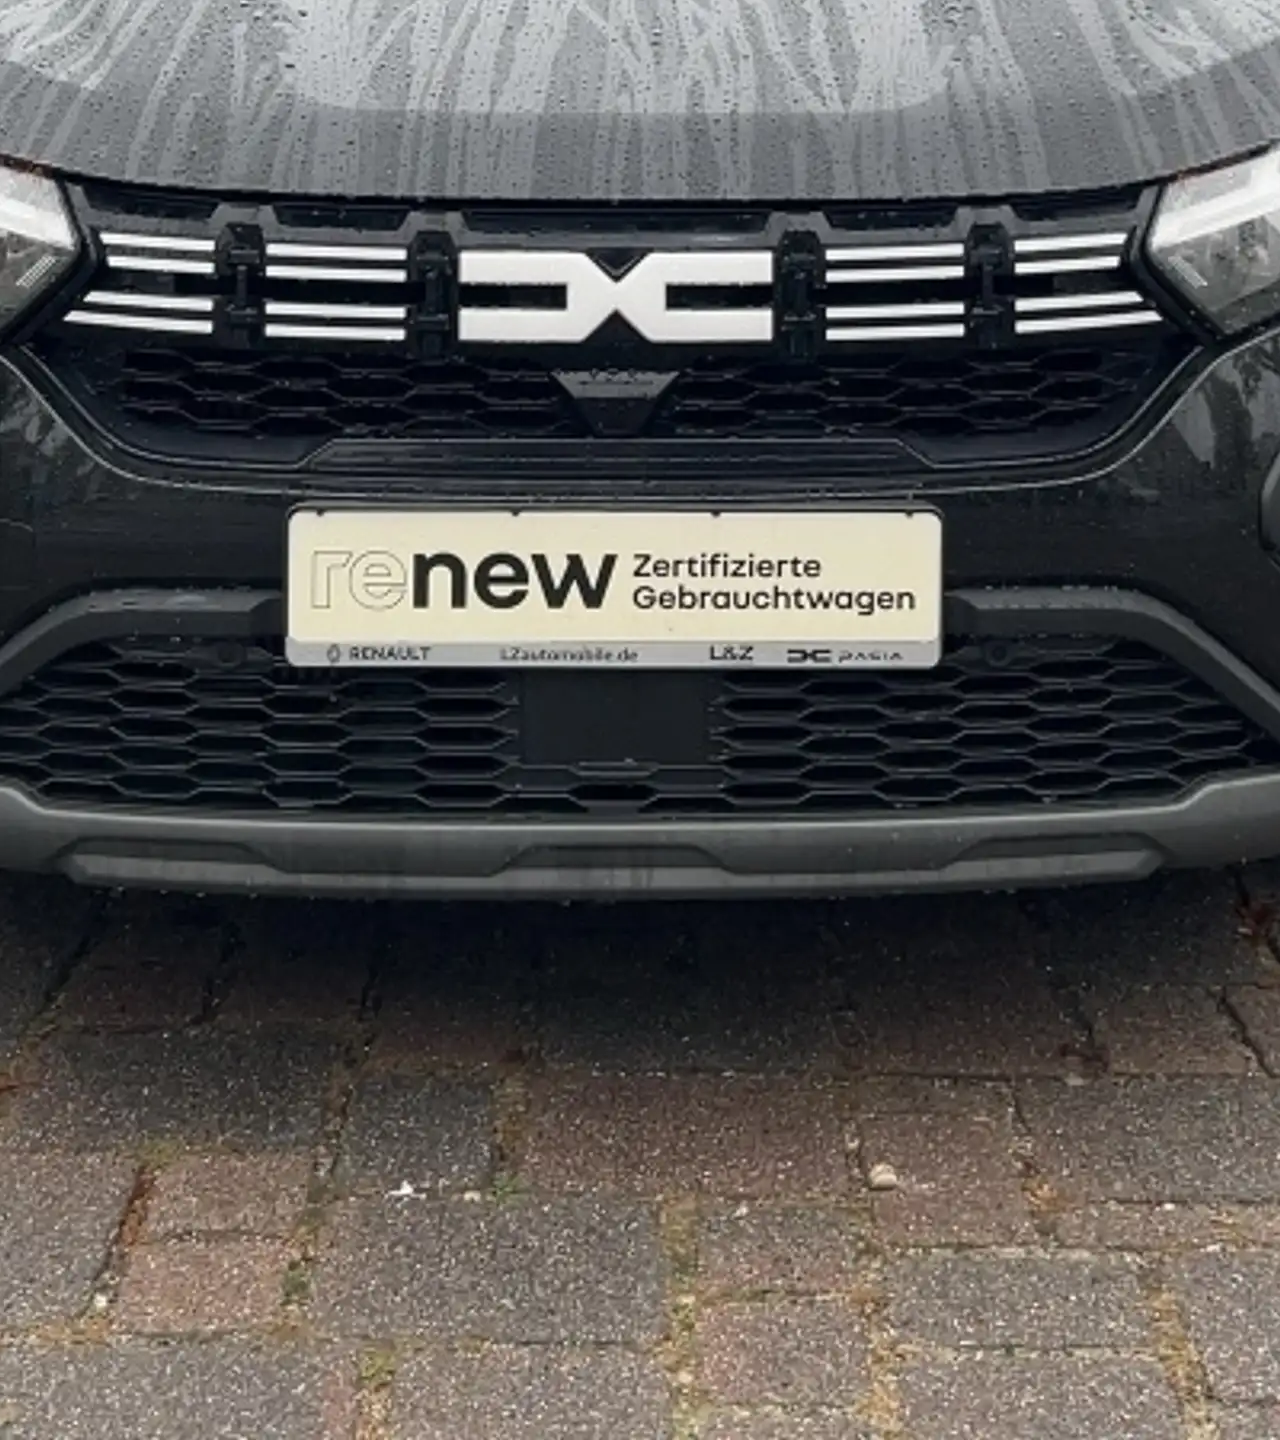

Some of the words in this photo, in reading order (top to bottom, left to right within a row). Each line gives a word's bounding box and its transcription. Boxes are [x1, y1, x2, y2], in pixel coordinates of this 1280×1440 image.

[633, 553, 821, 577] Zertifizierte
[311, 549, 618, 610] renew
[633, 585, 915, 616] Gebrauchtwagen
[349, 647, 431, 660] RENAULT
[709, 645, 754, 661] L&Z
